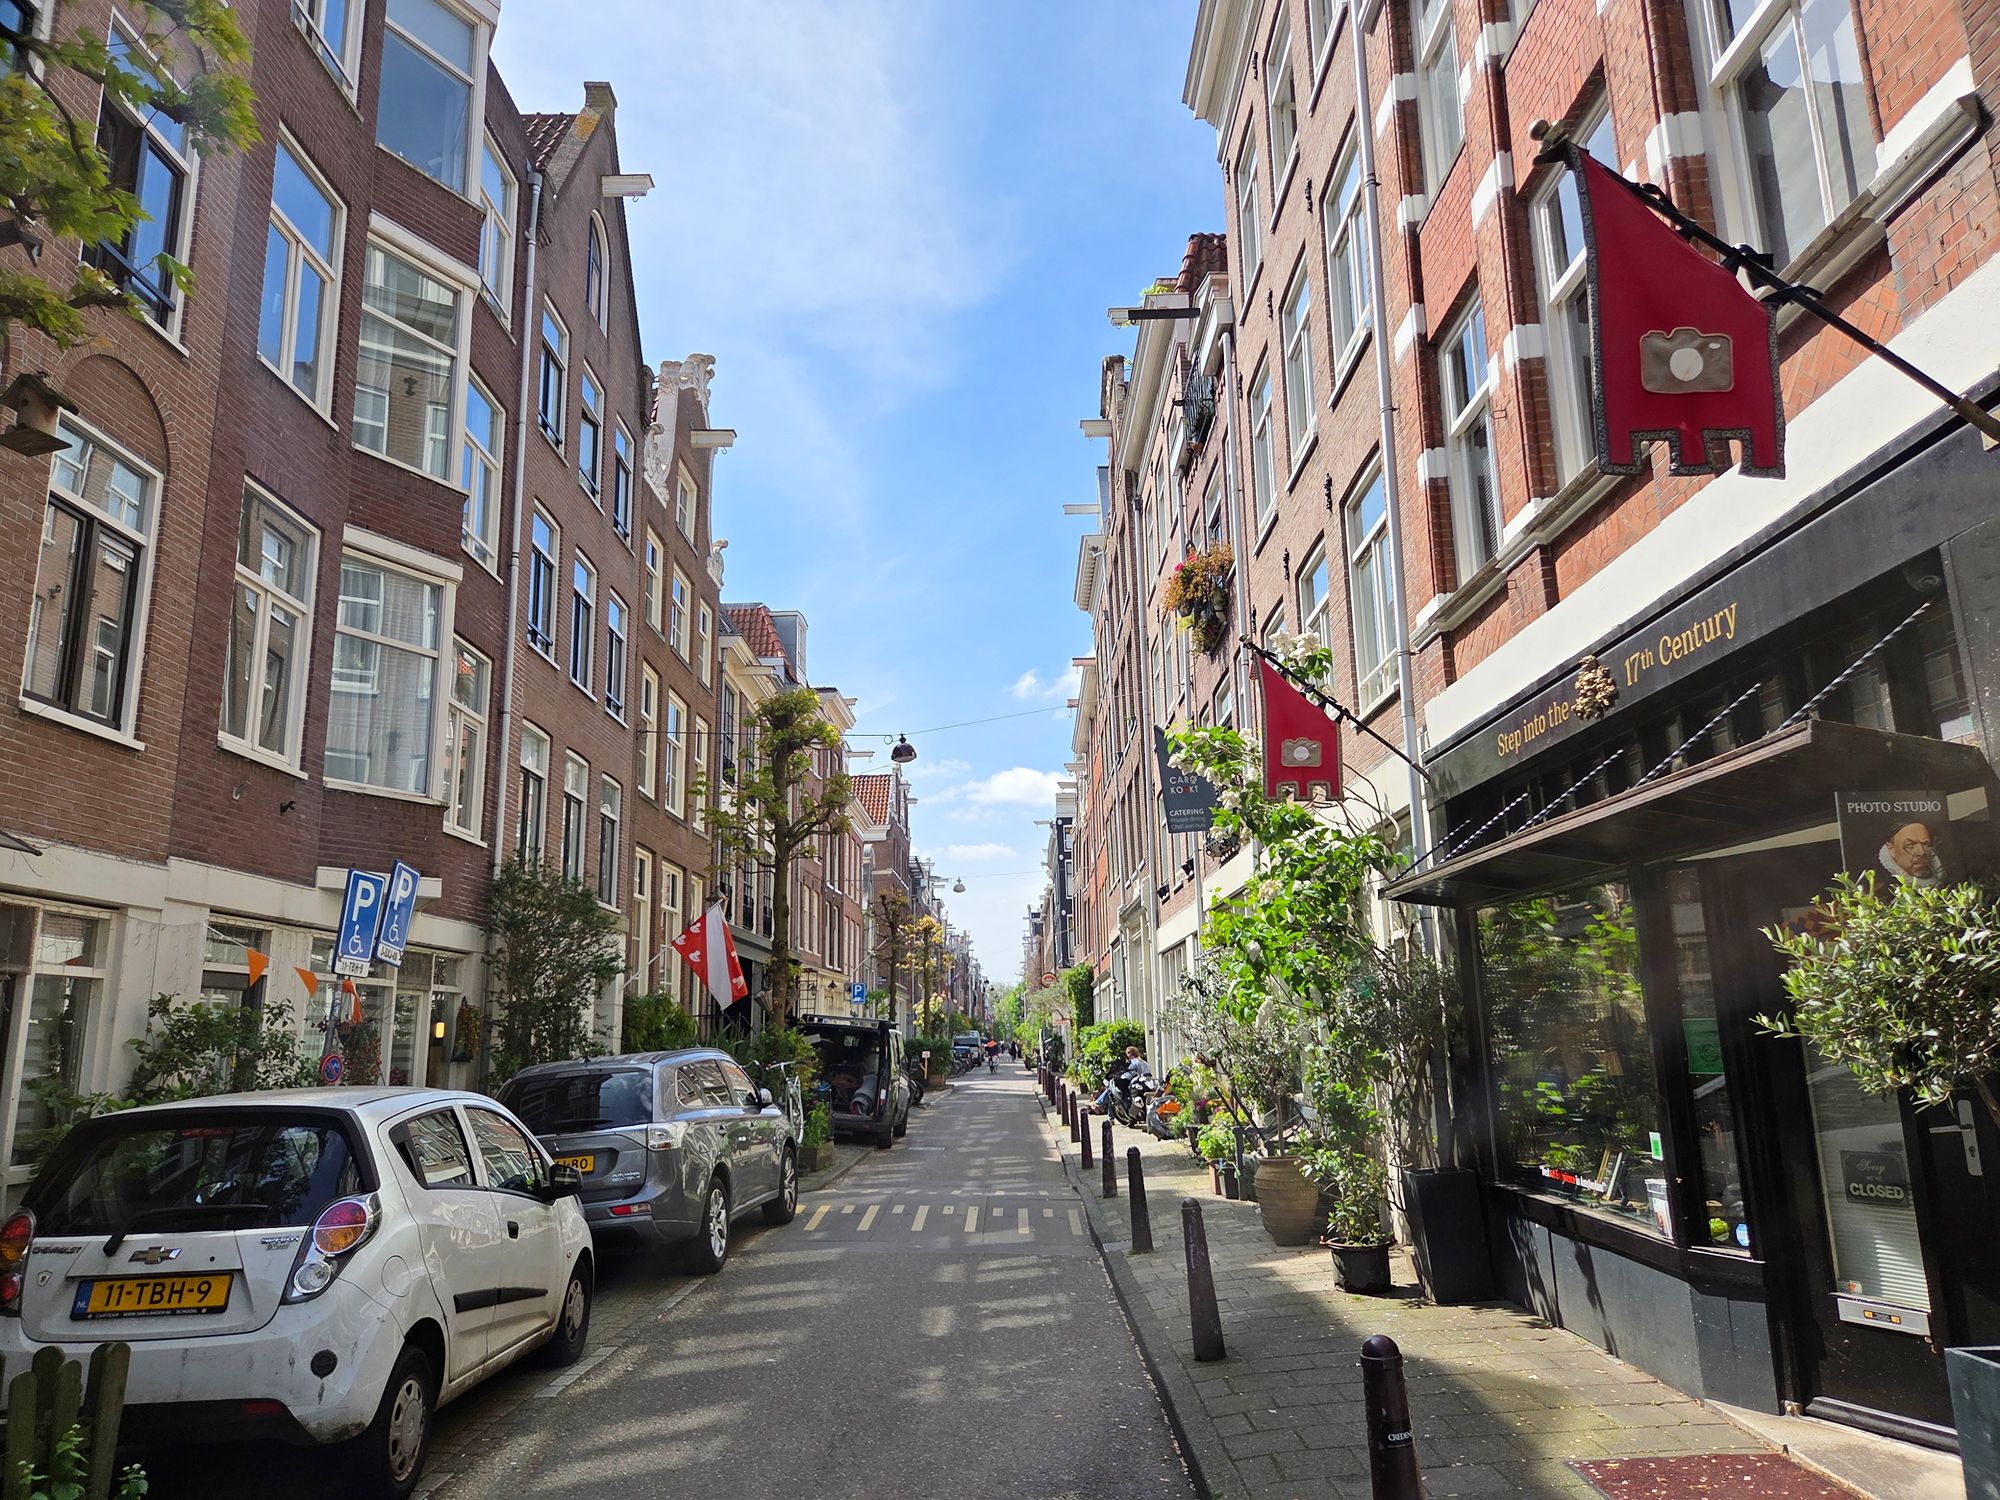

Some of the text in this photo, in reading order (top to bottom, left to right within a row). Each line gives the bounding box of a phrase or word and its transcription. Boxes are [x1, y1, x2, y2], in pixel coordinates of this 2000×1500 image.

[1497, 601, 1738, 757] Step into the 17th Century
[1169, 808, 1205, 817] CATERING
[1847, 801, 1941, 813] PHOTO STUDIO
[394, 870, 413, 911] P
[352, 879, 376, 921] P
[854, 984, 863, 996] P
[1856, 1158, 1886, 1175] Sorry
[1850, 1183, 1905, 1200] CLOSED
[104, 1280, 213, 1307] 11-TBH-9
